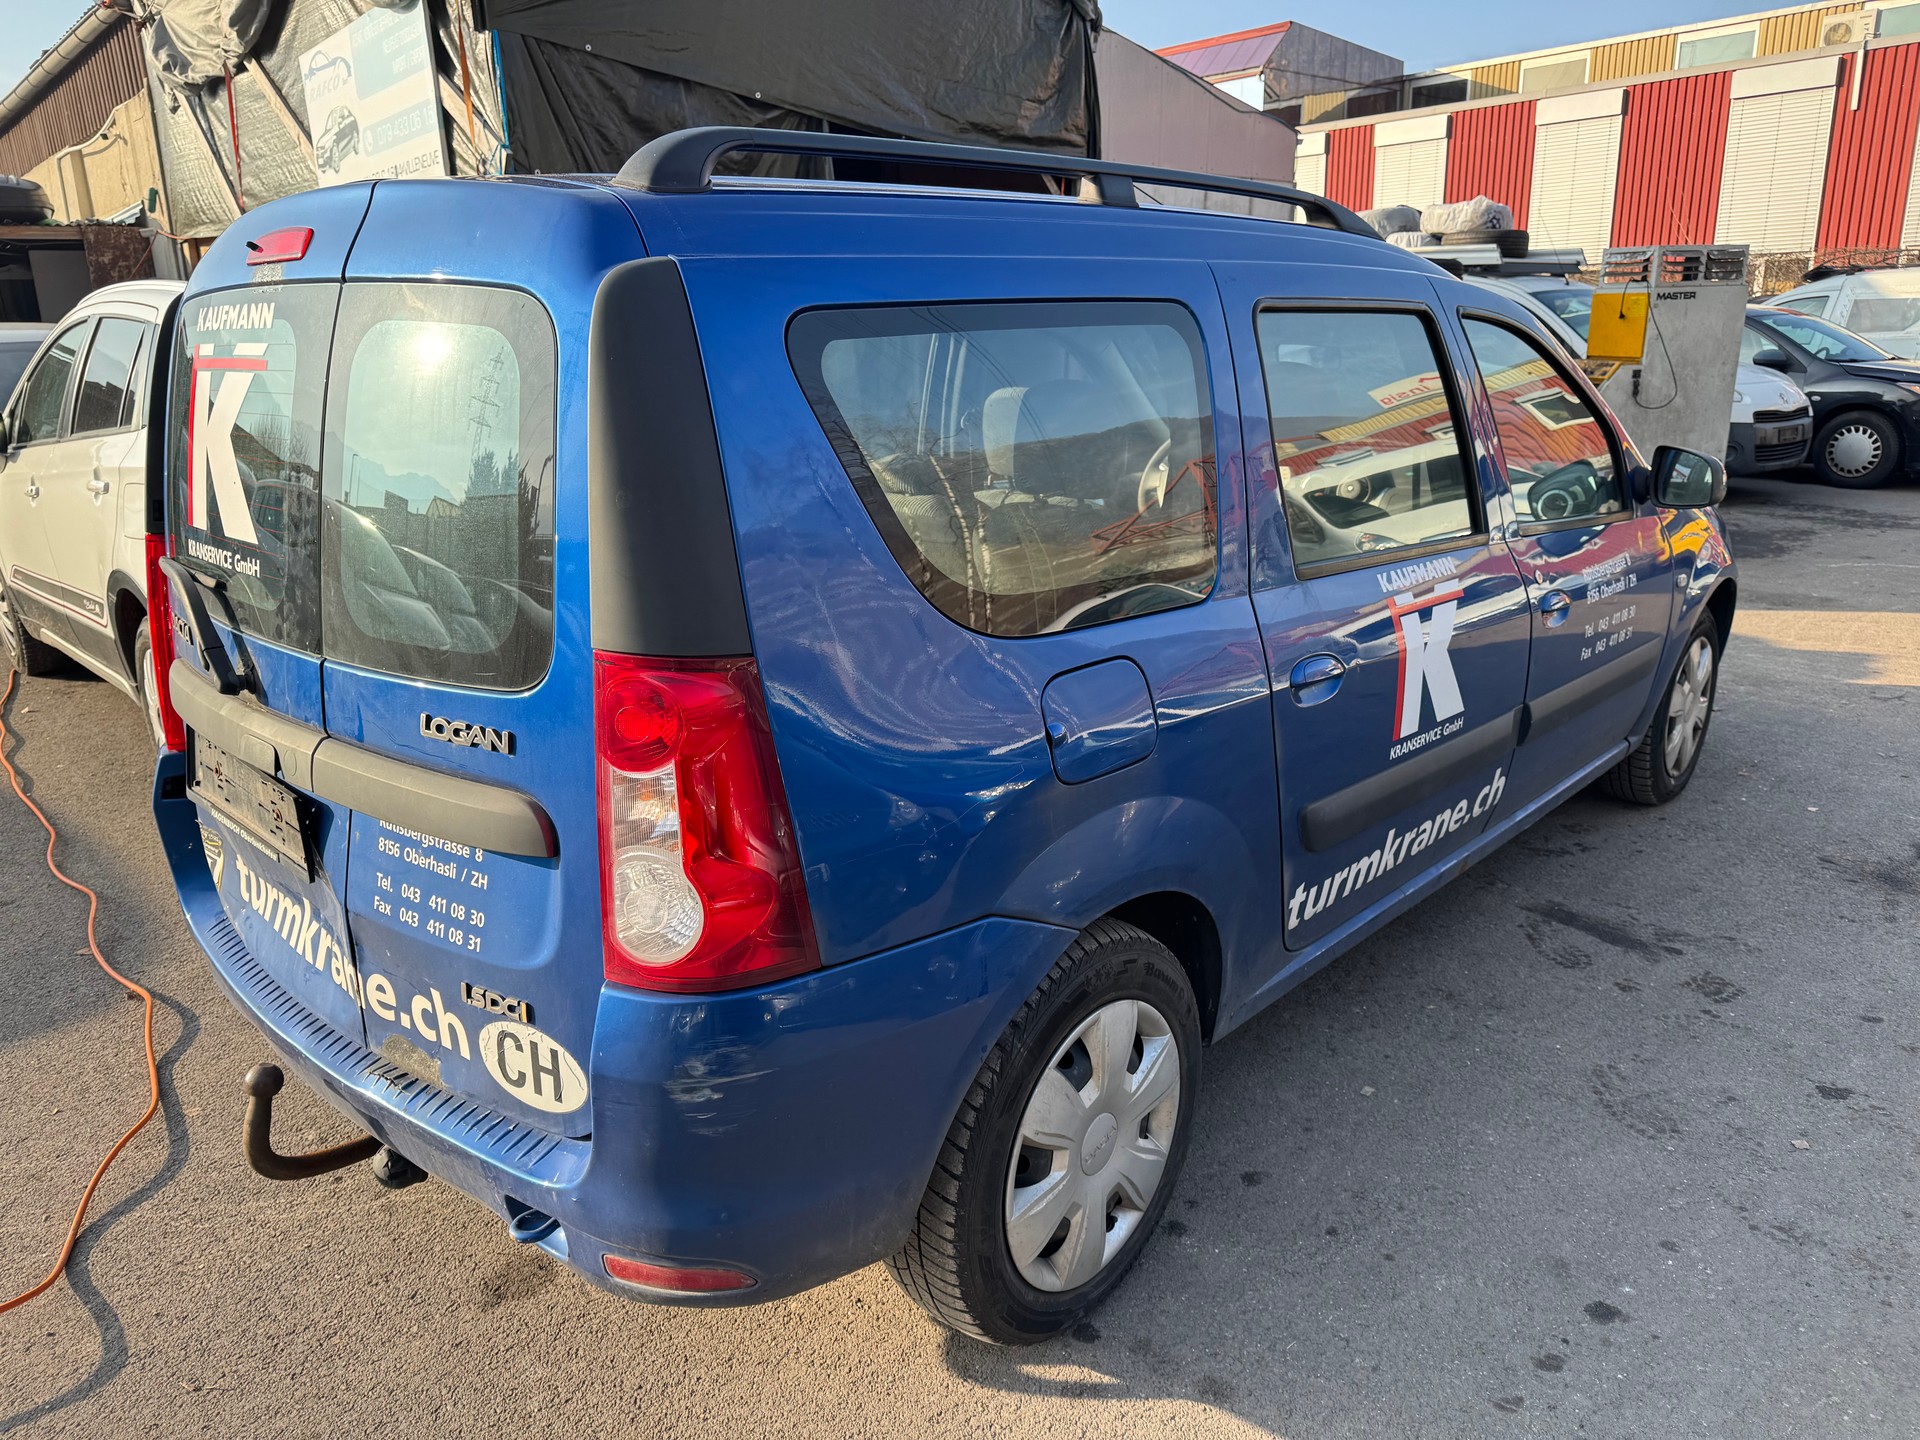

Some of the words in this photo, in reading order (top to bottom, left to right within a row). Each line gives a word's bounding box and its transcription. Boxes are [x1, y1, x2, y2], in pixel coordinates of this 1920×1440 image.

[1656, 291, 1697, 301] MASTER
[197, 302, 275, 333] KAUFMANN
[188, 539, 232, 570] KRANSERVICE
[234, 554, 261, 578] GmbH
[1377, 556, 1456, 592] KAUFMANN
[1601, 577, 1625, 599] Oberhasli
[1598, 616, 1609, 633] 043
[1612, 611, 1621, 626] 411
[1580, 647, 1592, 661] Fax
[1595, 638, 1607, 654] 043
[1609, 632, 1618, 647] 411
[420, 711, 512, 756] LOGAN
[1389, 726, 1442, 760] KRANSERVICE
[1443, 716, 1464, 736] GmbH
[211, 808, 240, 835] HAGENBUCH
[378, 837, 400, 858] 8156
[404, 847, 457, 880] Oberhasli
[470, 871, 488, 890] ZH
[475, 847, 483, 862] 8
[1287, 767, 1506, 931] turmkrane.ch
[376, 872, 393, 893] Tel.
[401, 883, 421, 903] 043
[429, 895, 447, 914] 411
[450, 903, 465, 921] 08
[469, 910, 485, 928] 30
[374, 896, 392, 916] Fax
[399, 908, 419, 928] 043
[427, 919, 445, 939] 411
[448, 928, 463, 945] 08
[467, 934, 481, 953] 31
[236, 854, 471, 1062] turmkrane.ch
[497, 1029, 563, 1104] CH
